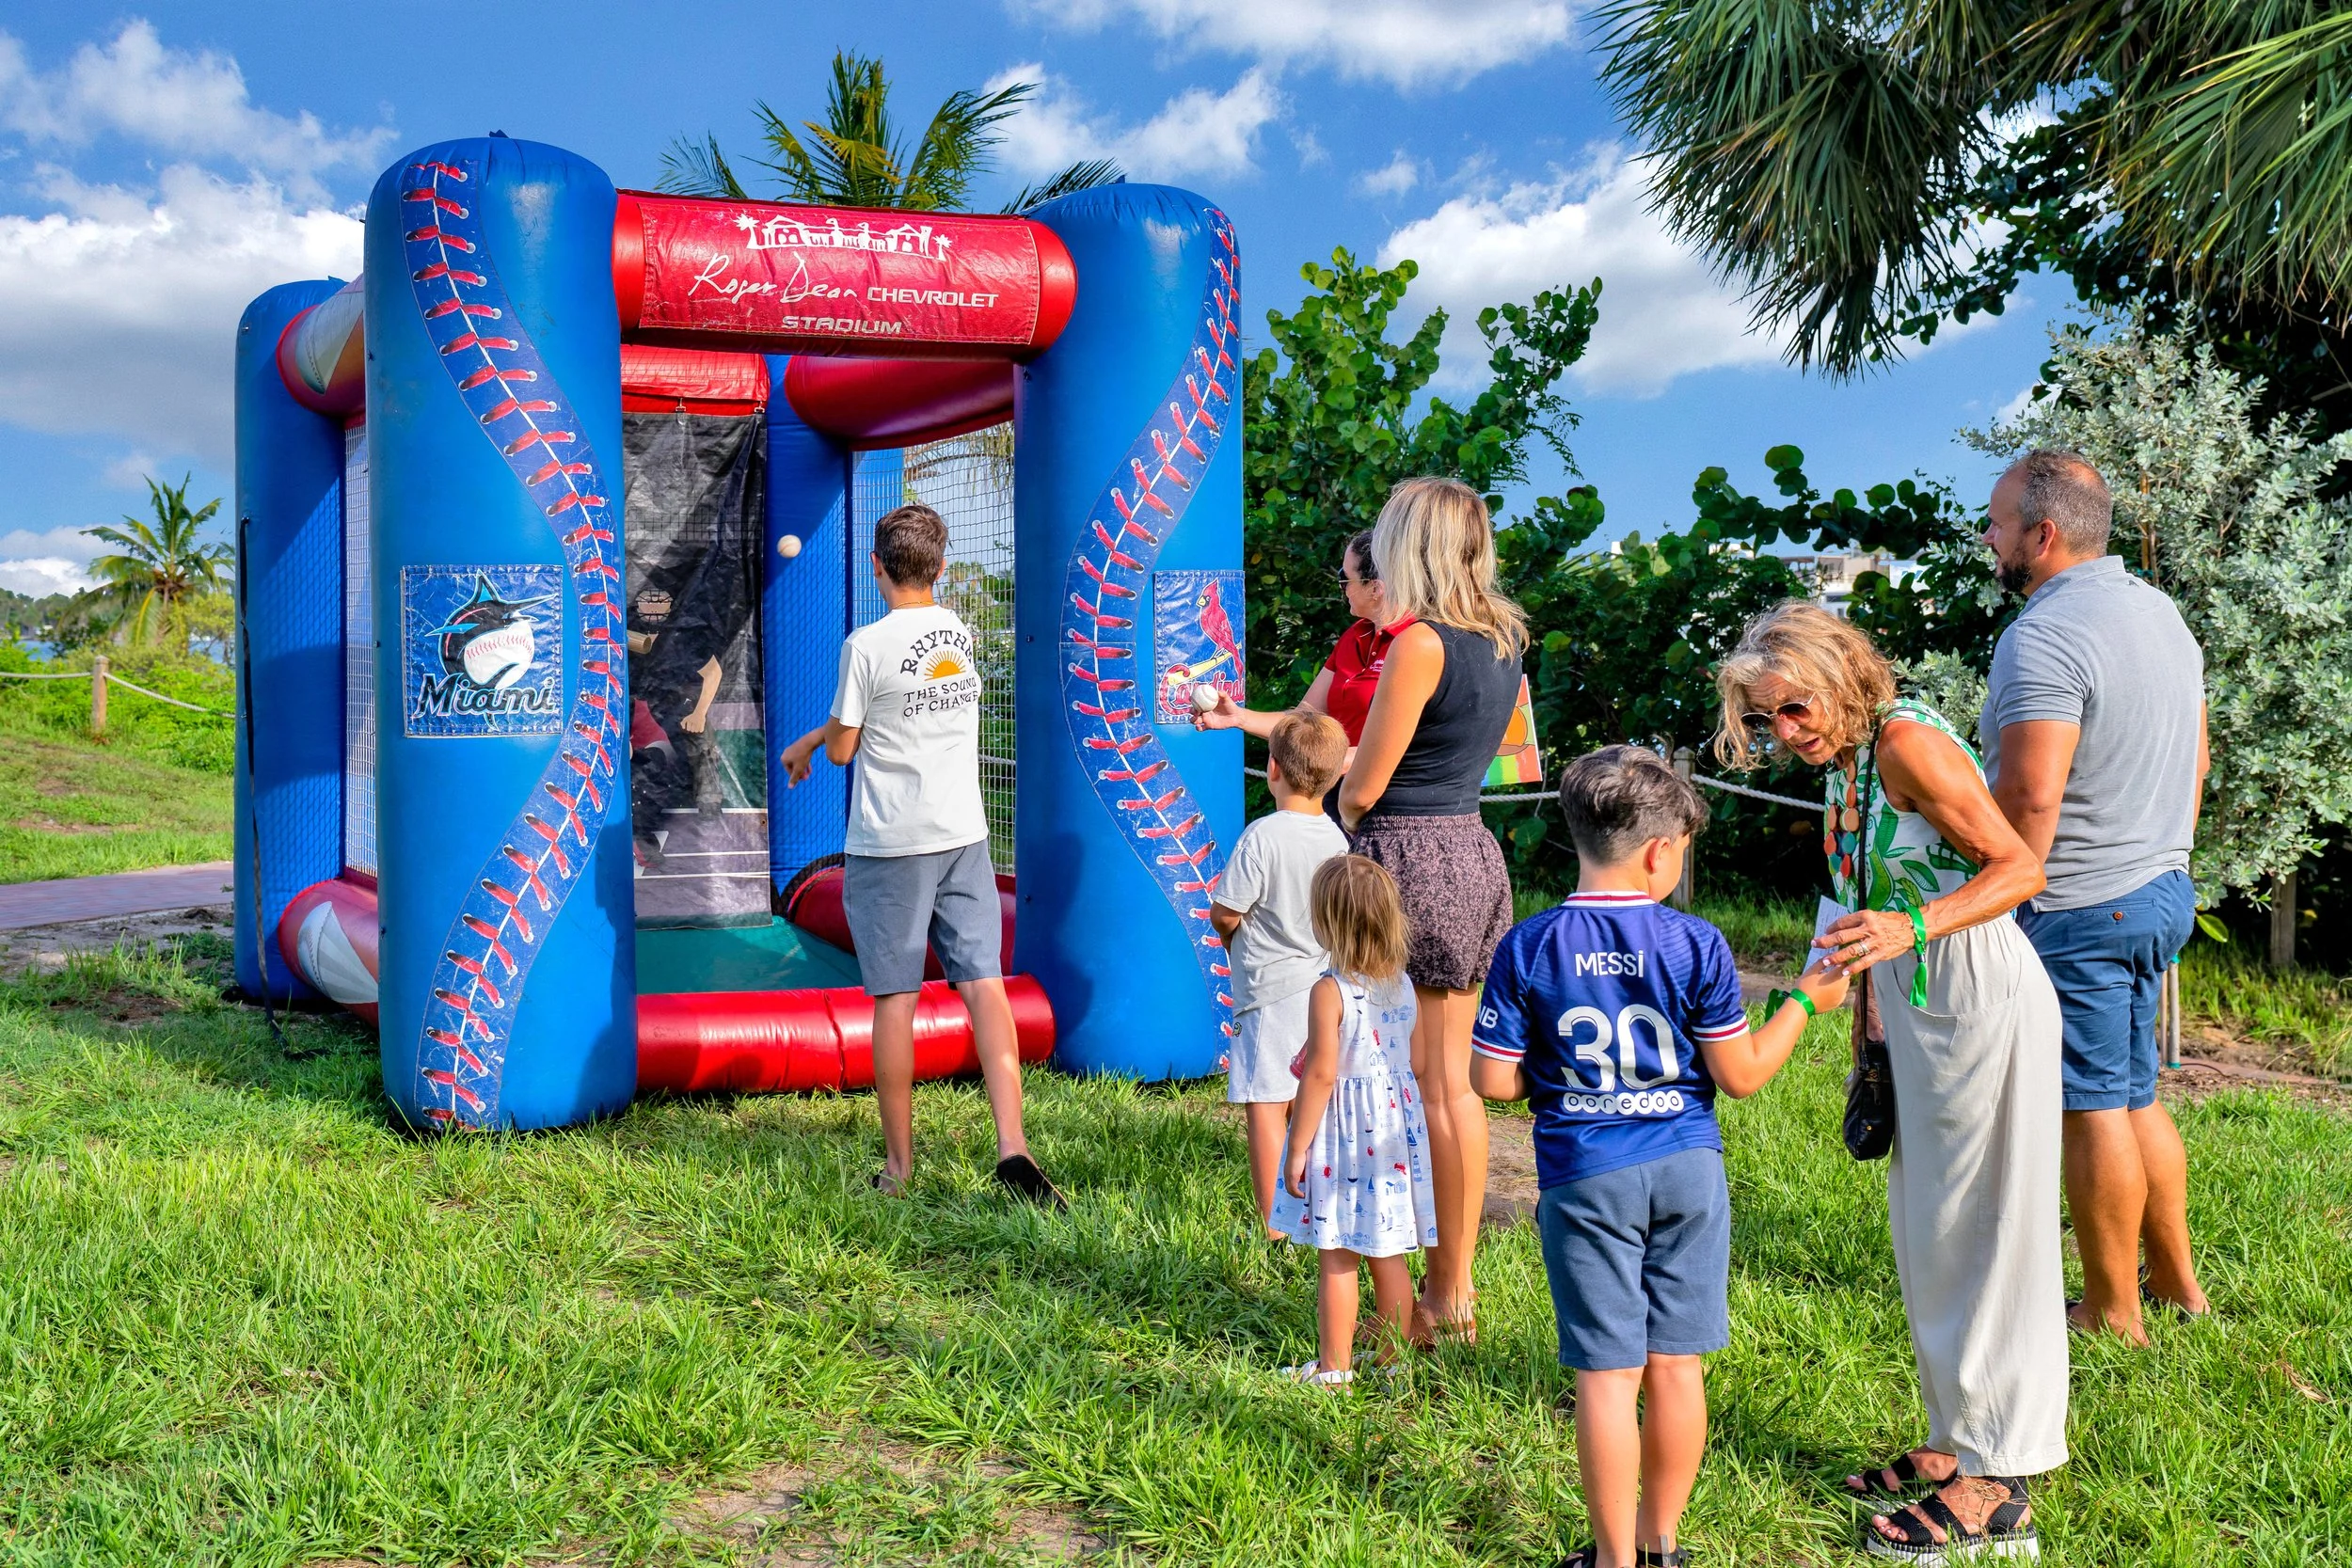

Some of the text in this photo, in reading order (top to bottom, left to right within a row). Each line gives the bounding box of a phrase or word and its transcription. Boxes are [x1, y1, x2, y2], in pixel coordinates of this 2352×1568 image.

[780, 250, 858, 304] Dean
[866, 286, 999, 309] CHEVROLET
[782, 316, 902, 335] STADIUM
[410, 672, 560, 720] Miami
[903, 686, 939, 704] THE
[903, 703, 925, 718] OF
[1557, 1004, 1680, 1092] 30
[1563, 1090, 1684, 1116] ooredoo
